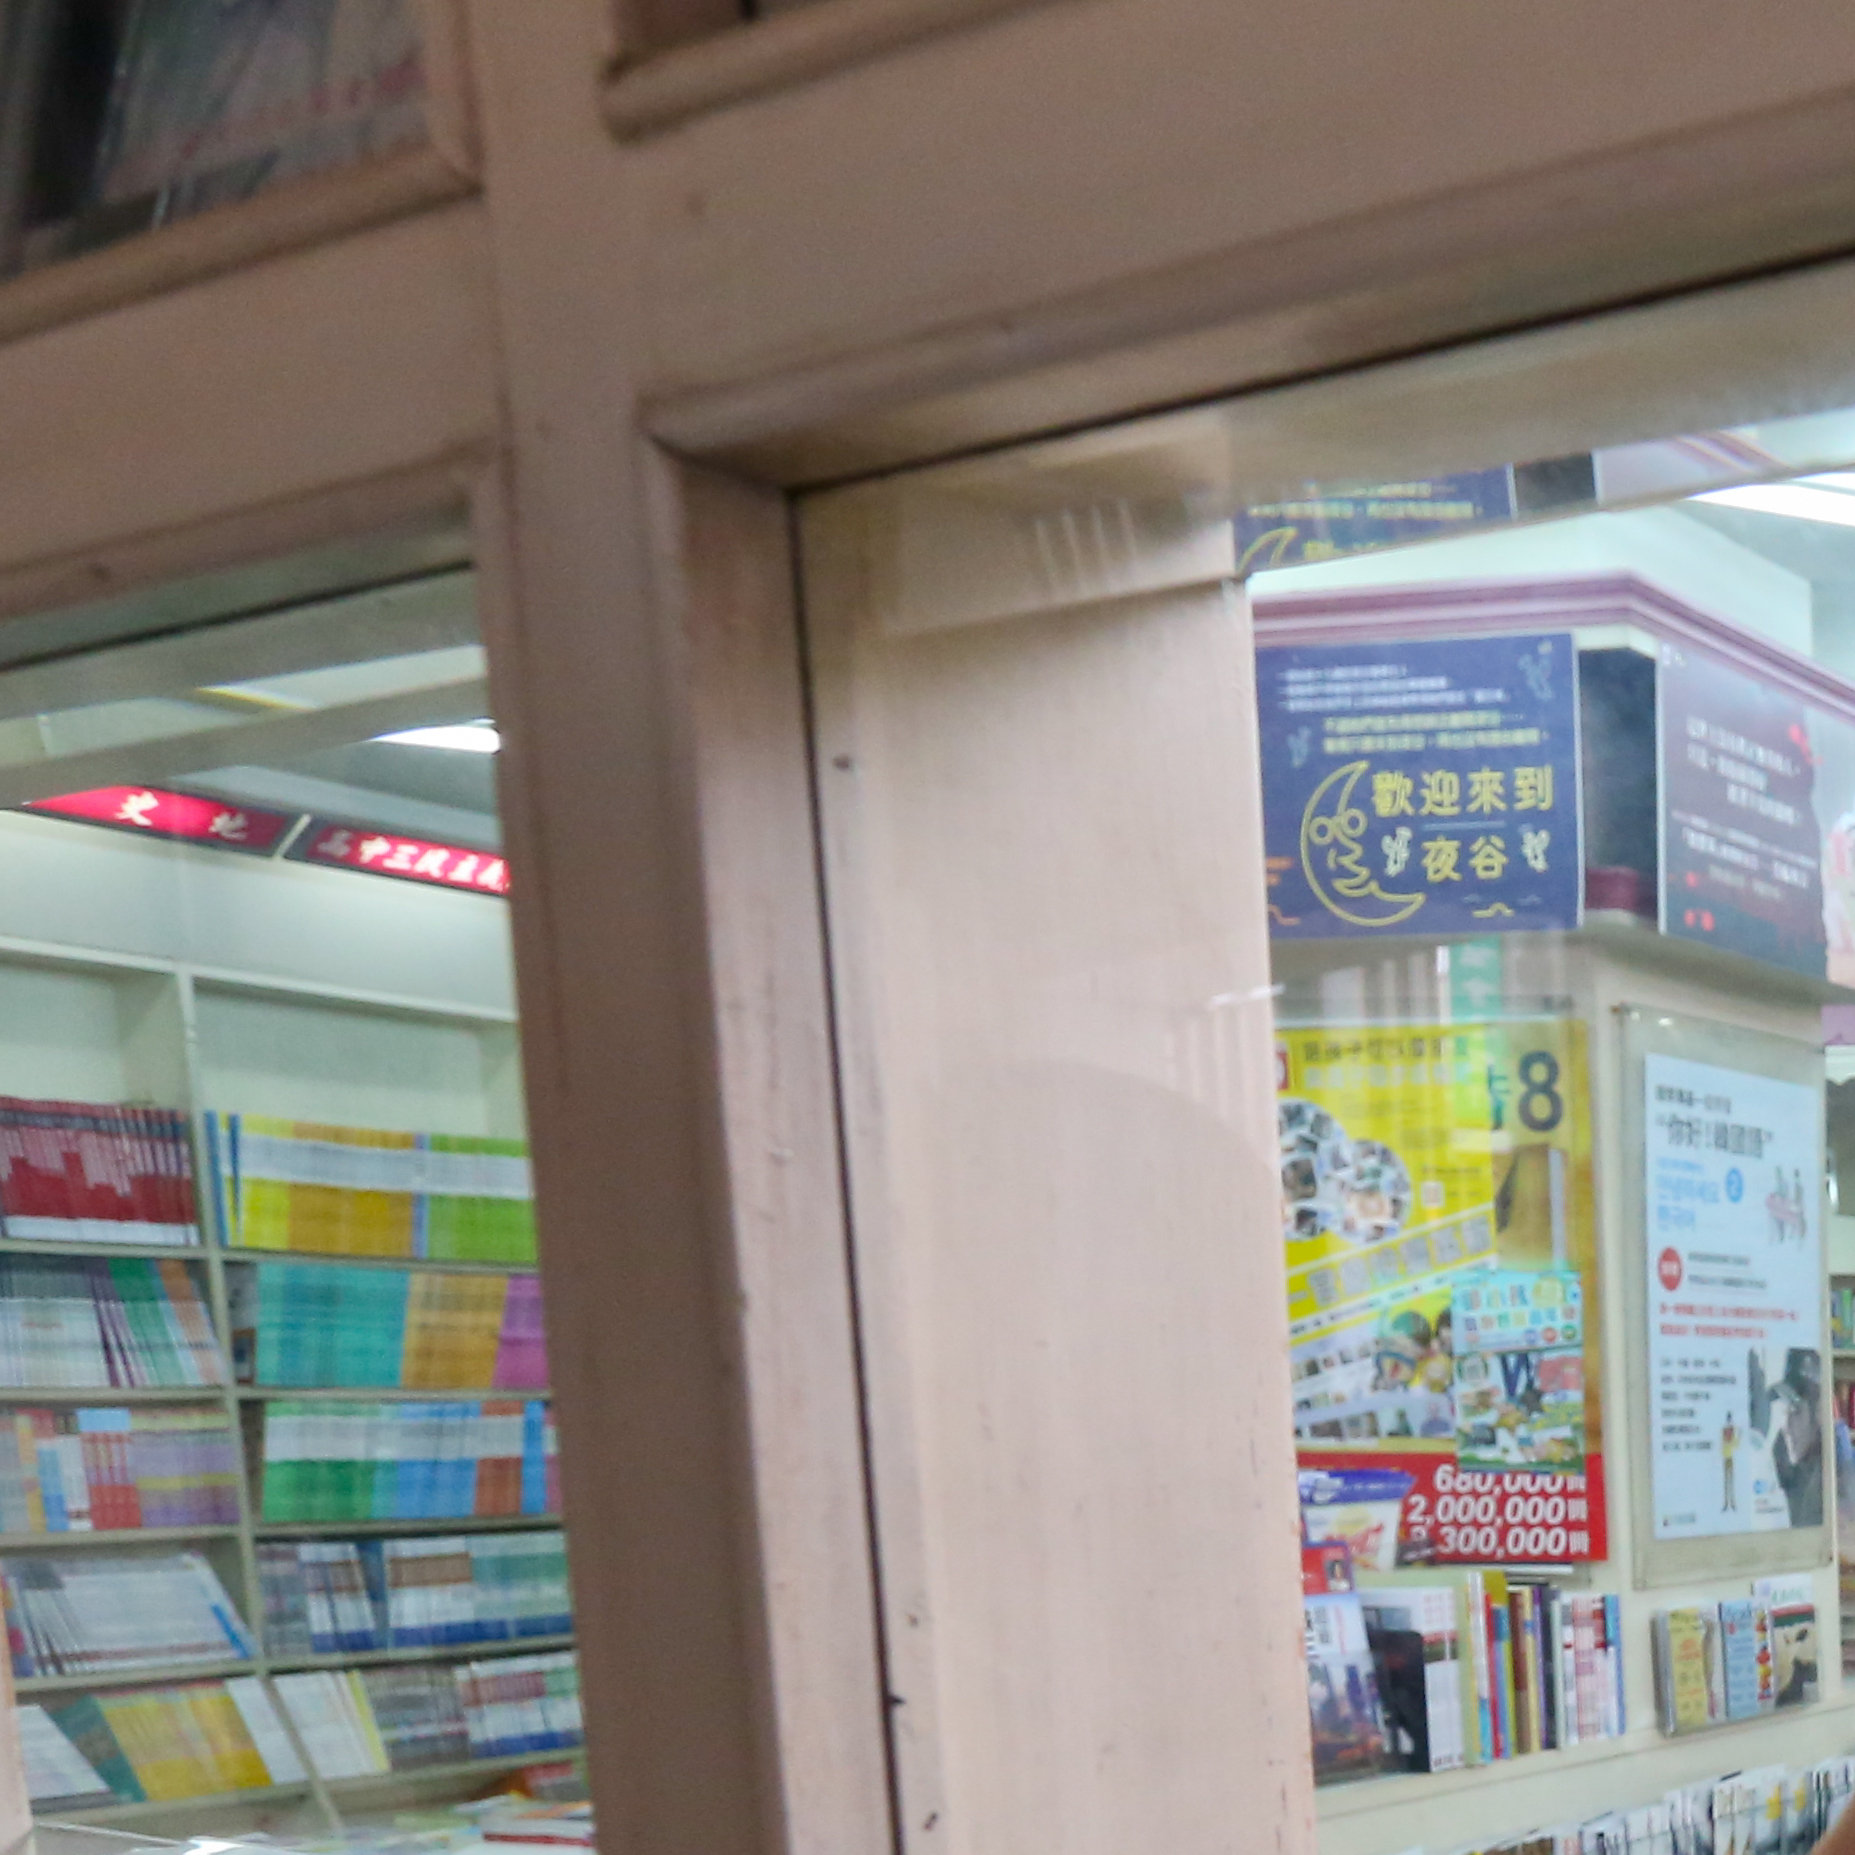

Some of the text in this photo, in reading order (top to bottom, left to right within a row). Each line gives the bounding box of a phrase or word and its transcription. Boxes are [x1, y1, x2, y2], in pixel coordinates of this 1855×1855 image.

[1371, 764, 1554, 817] 歡迎來到
[1419, 833, 1508, 884] 夜谷
[1517, 1049, 1564, 1132] 8
